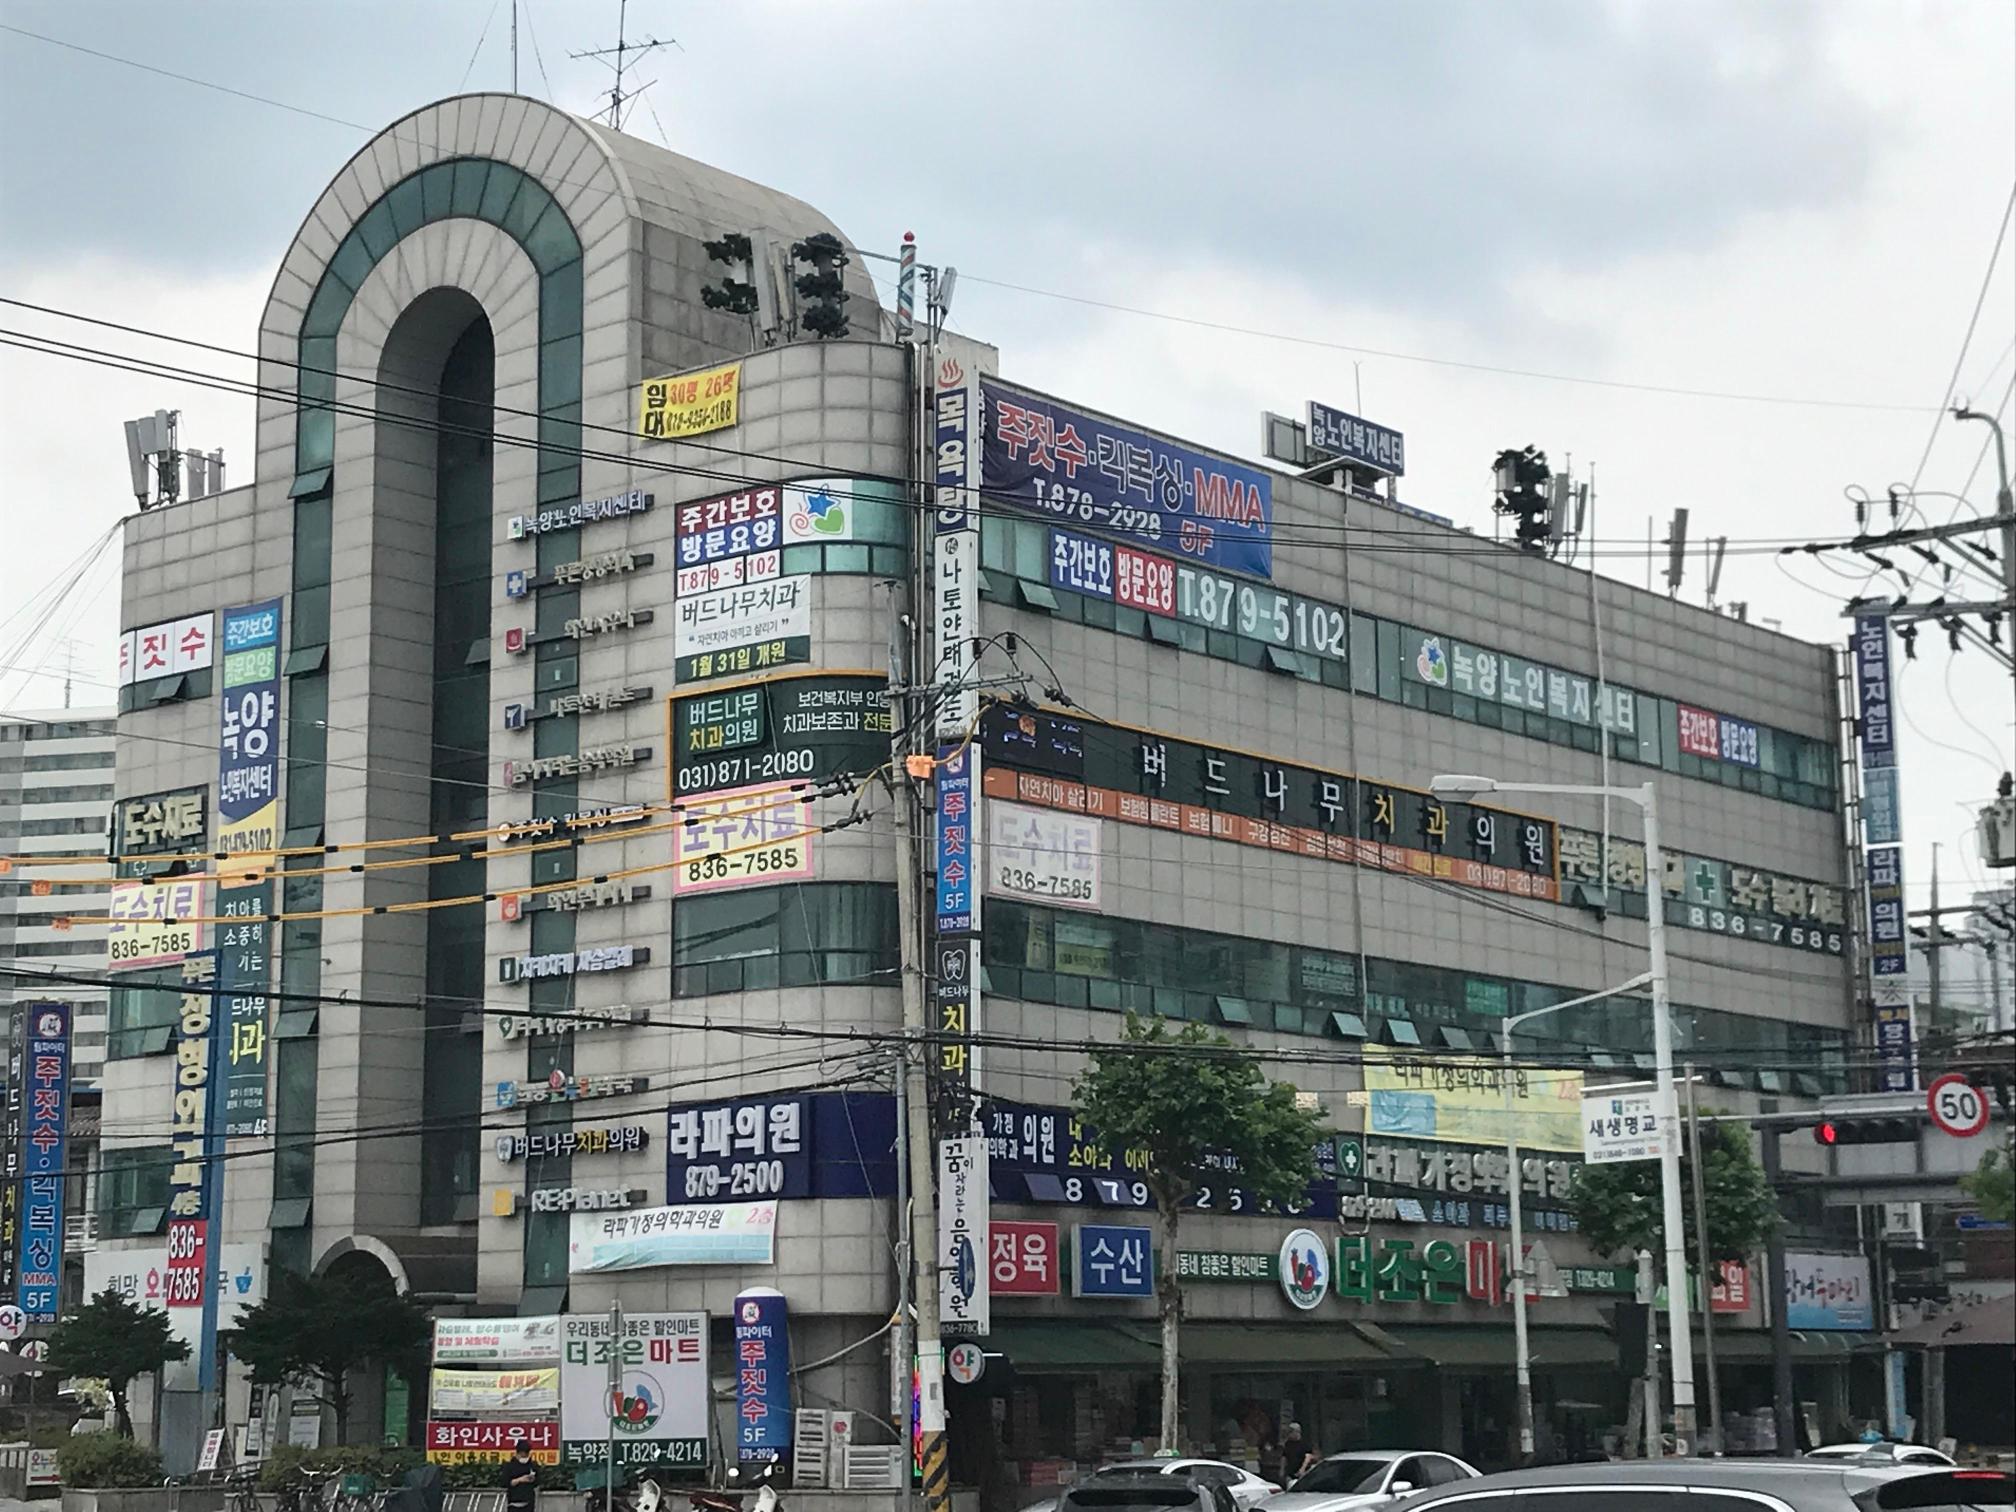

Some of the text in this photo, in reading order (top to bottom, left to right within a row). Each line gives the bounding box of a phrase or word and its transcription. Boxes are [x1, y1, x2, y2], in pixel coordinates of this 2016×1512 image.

[938, 393, 967, 524] 목욕탕
[1328, 413, 1403, 468] 노인복지센터
[525, 490, 646, 533] 녹양노인복지센터
[681, 489, 777, 533] 주간보호
[1033, 477, 1162, 541] T.878-2928
[681, 518, 777, 564] 방문요양
[1180, 519, 1214, 556] 5F
[682, 580, 800, 628] 버드나무치과
[1054, 534, 1346, 657] 주간보호 방문요양 T.879-5102
[226, 613, 274, 645] 주간보호
[224, 650, 274, 683] 방문요양
[690, 640, 786, 678] 1월 31일 개원
[798, 690, 863, 708] 보건복지부
[1453, 645, 1634, 733] 녹양노인복지센터
[222, 690, 274, 760] 녹양
[690, 692, 758, 726] 버드나무
[783, 712, 861, 734] 치과보존과
[690, 719, 758, 751] 치과의원
[1680, 709, 1718, 755] 주간보호
[220, 764, 272, 804] 노인복지센터
[679, 749, 815, 791] 031)871-2080
[1019, 776, 1064, 804] 자연치아
[1067, 784, 1104, 811] 살리기
[683, 793, 797, 852] 도수치료
[944, 792, 967, 889] 주짓수
[688, 847, 799, 883] 836-7585
[999, 865, 1093, 900] 836-7585
[110, 884, 193, 934] 도수치료
[224, 898, 263, 919] 치아를
[945, 892, 965, 910] 5F
[111, 931, 191, 961] 836-7585
[224, 924, 263, 947] 소중히
[1689, 907, 1842, 952] 836-7585
[230, 995, 265, 1018] 드나무
[940, 1003, 968, 1077] 치과
[32, 1056, 62, 1155] 주짓수
[993, 1112, 1014, 1135] 가정
[1942, 1093, 1978, 1120] 50
[515, 1125, 641, 1159] 버드나무치과의원
[671, 1102, 801, 1160] 라파의원
[1023, 1114, 1055, 1164] 의원
[1590, 1114, 1660, 1138] 새생명교
[989, 1137, 1019, 1161] 의학과
[684, 1160, 785, 1199] 879-2500
[28, 1170, 57, 1271] 킥복싱
[603, 1208, 725, 1239] 라파가정의학과의원
[992, 1233, 1144, 1286] 정육 수산
[1231, 1255, 1269, 1277] 할인마트
[22, 1271, 57, 1287] MMA
[168, 1267, 200, 1301] 7585
[26, 1292, 52, 1309] 5F
[654, 1318, 701, 1336] 할인마트
[740, 1339, 768, 1425] 주짓수
[951, 1349, 975, 1380] 약
[435, 1426, 552, 1448] 화인사우나
[744, 1427, 766, 1443] 5F
